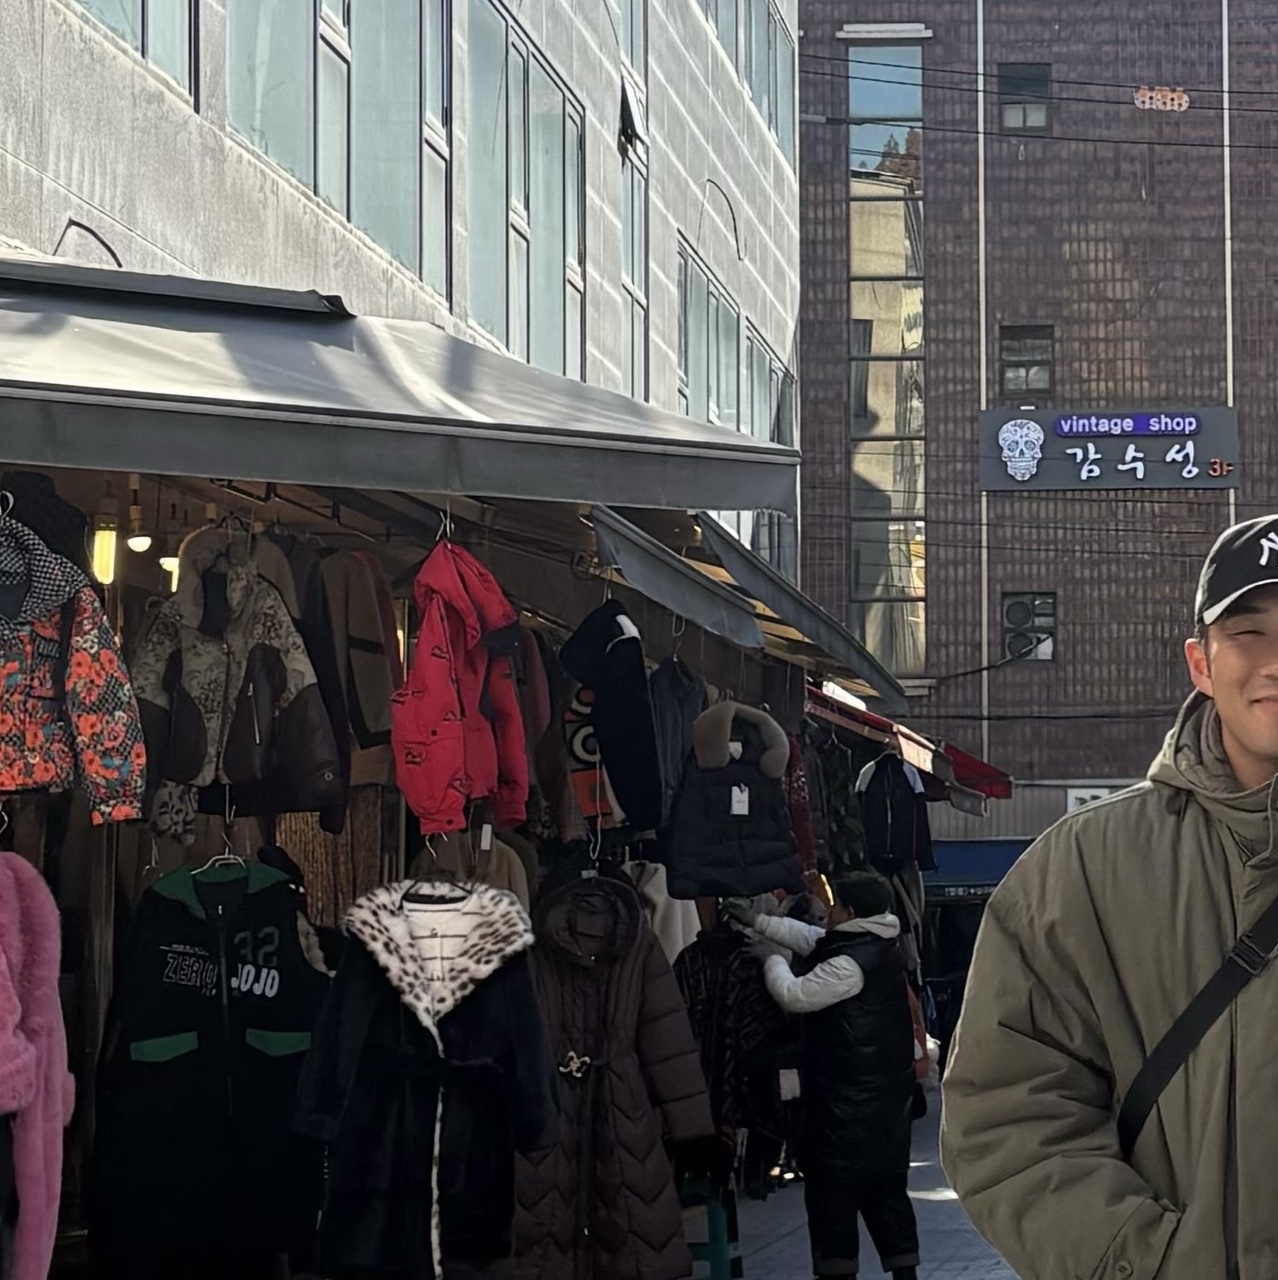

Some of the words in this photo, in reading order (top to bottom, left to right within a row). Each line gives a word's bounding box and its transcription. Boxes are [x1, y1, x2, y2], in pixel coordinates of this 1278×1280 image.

[1060, 415, 1134, 435] vintage
[1149, 414, 1197, 434] shop
[1065, 440, 1199, 480] 감수성
[230, 962, 281, 998] JOJO
